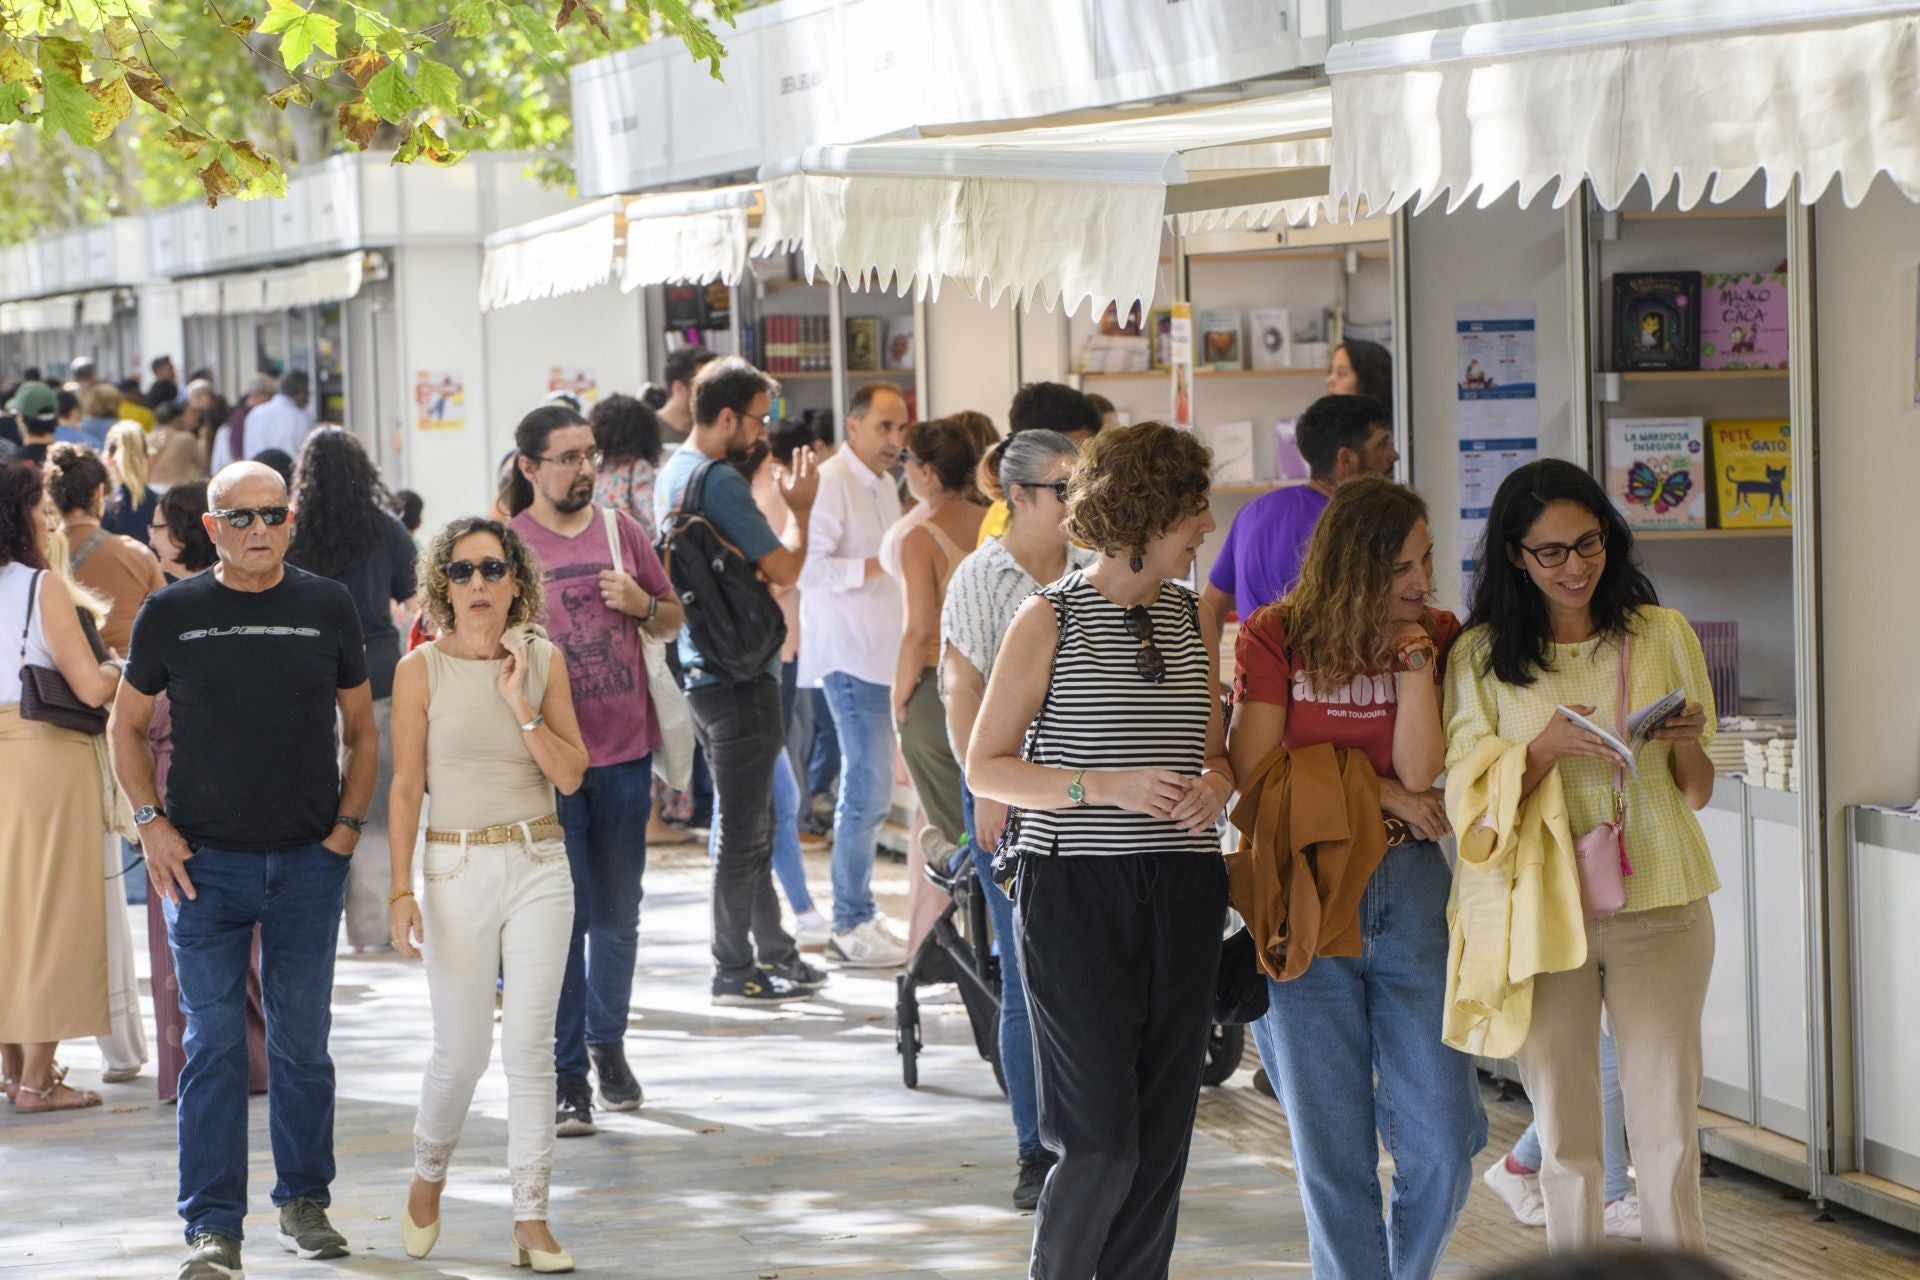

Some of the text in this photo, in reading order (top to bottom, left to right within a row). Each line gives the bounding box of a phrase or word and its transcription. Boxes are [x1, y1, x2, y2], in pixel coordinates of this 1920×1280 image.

[1722, 308, 1766, 323] CACA
[1625, 432, 1689, 441] LA MARIPOSA
[1719, 428, 1752, 443] PETE
[1633, 442, 1682, 452] INSEGURA
[1751, 440, 1787, 452] GATO
[1327, 708, 1387, 719] POUR TOUJOURS
